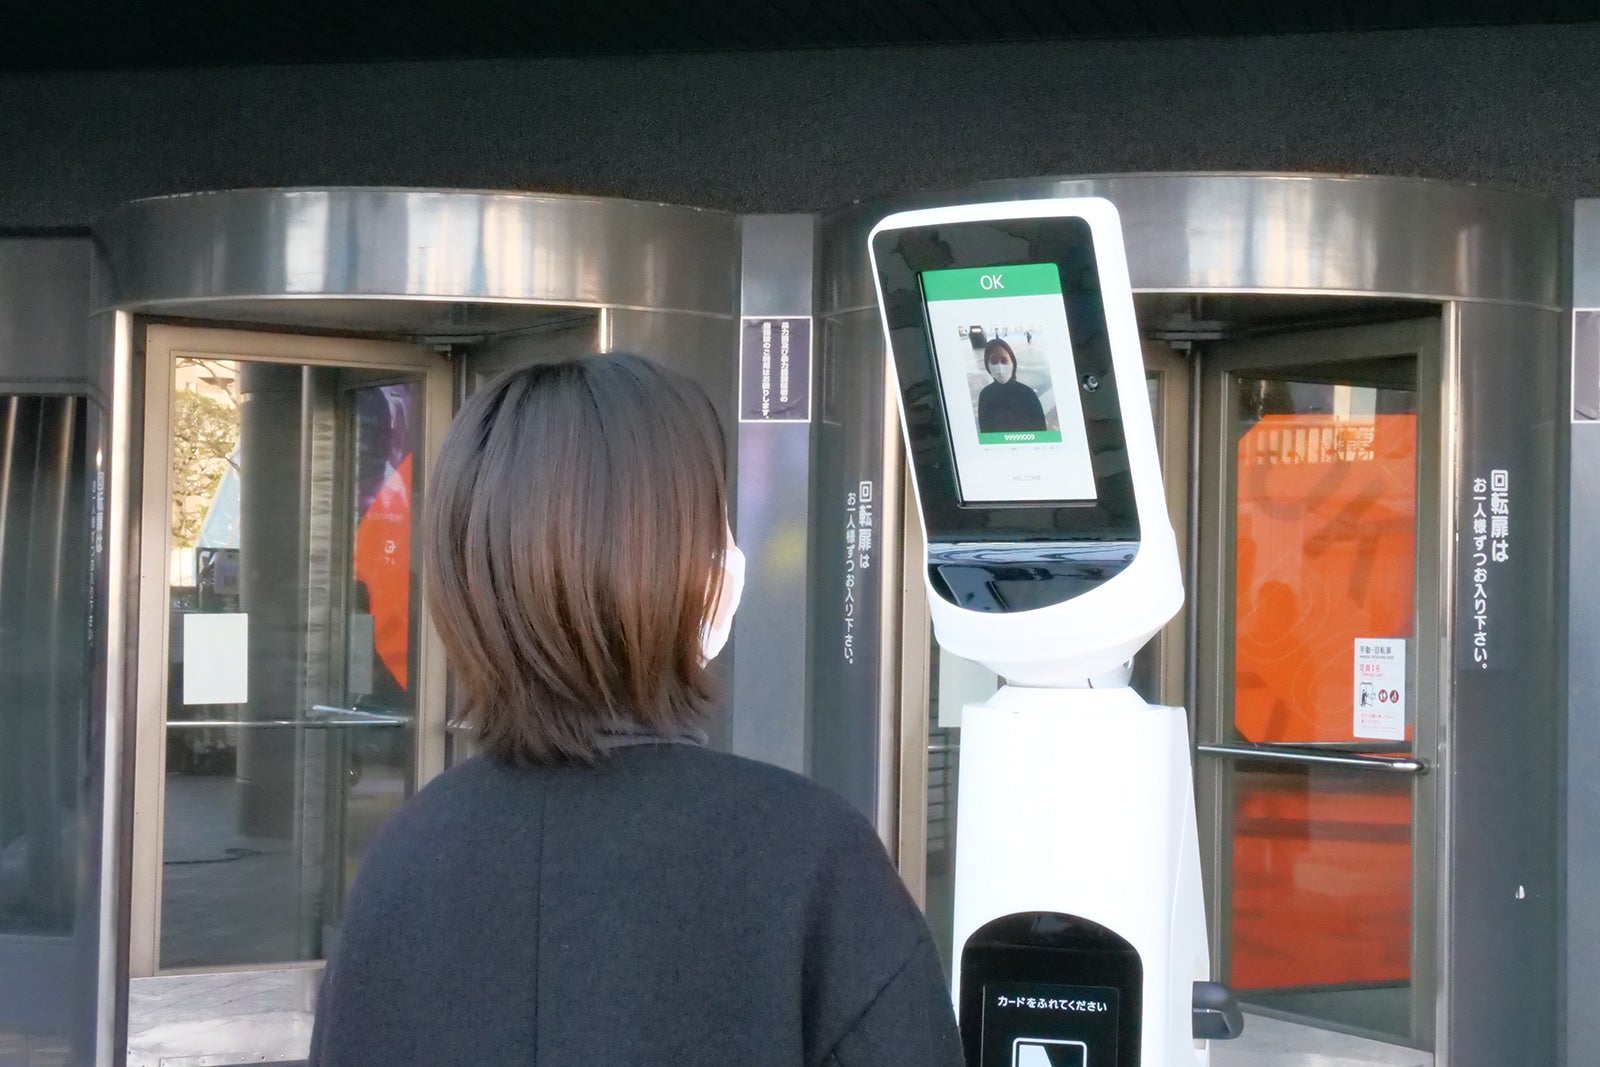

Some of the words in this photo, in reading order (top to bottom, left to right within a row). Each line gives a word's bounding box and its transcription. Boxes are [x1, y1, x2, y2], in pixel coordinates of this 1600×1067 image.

[980, 274, 1005, 290] OK
[858, 480, 872, 568] 回転扉は
[1490, 469, 1509, 562] 回転扉は
[844, 492, 856, 664] お一人様ずつお入り下さい。
[1473, 477, 1487, 669] お一人様ずつお入り下さい。
[998, 995, 1107, 1012] カードをふれてください
